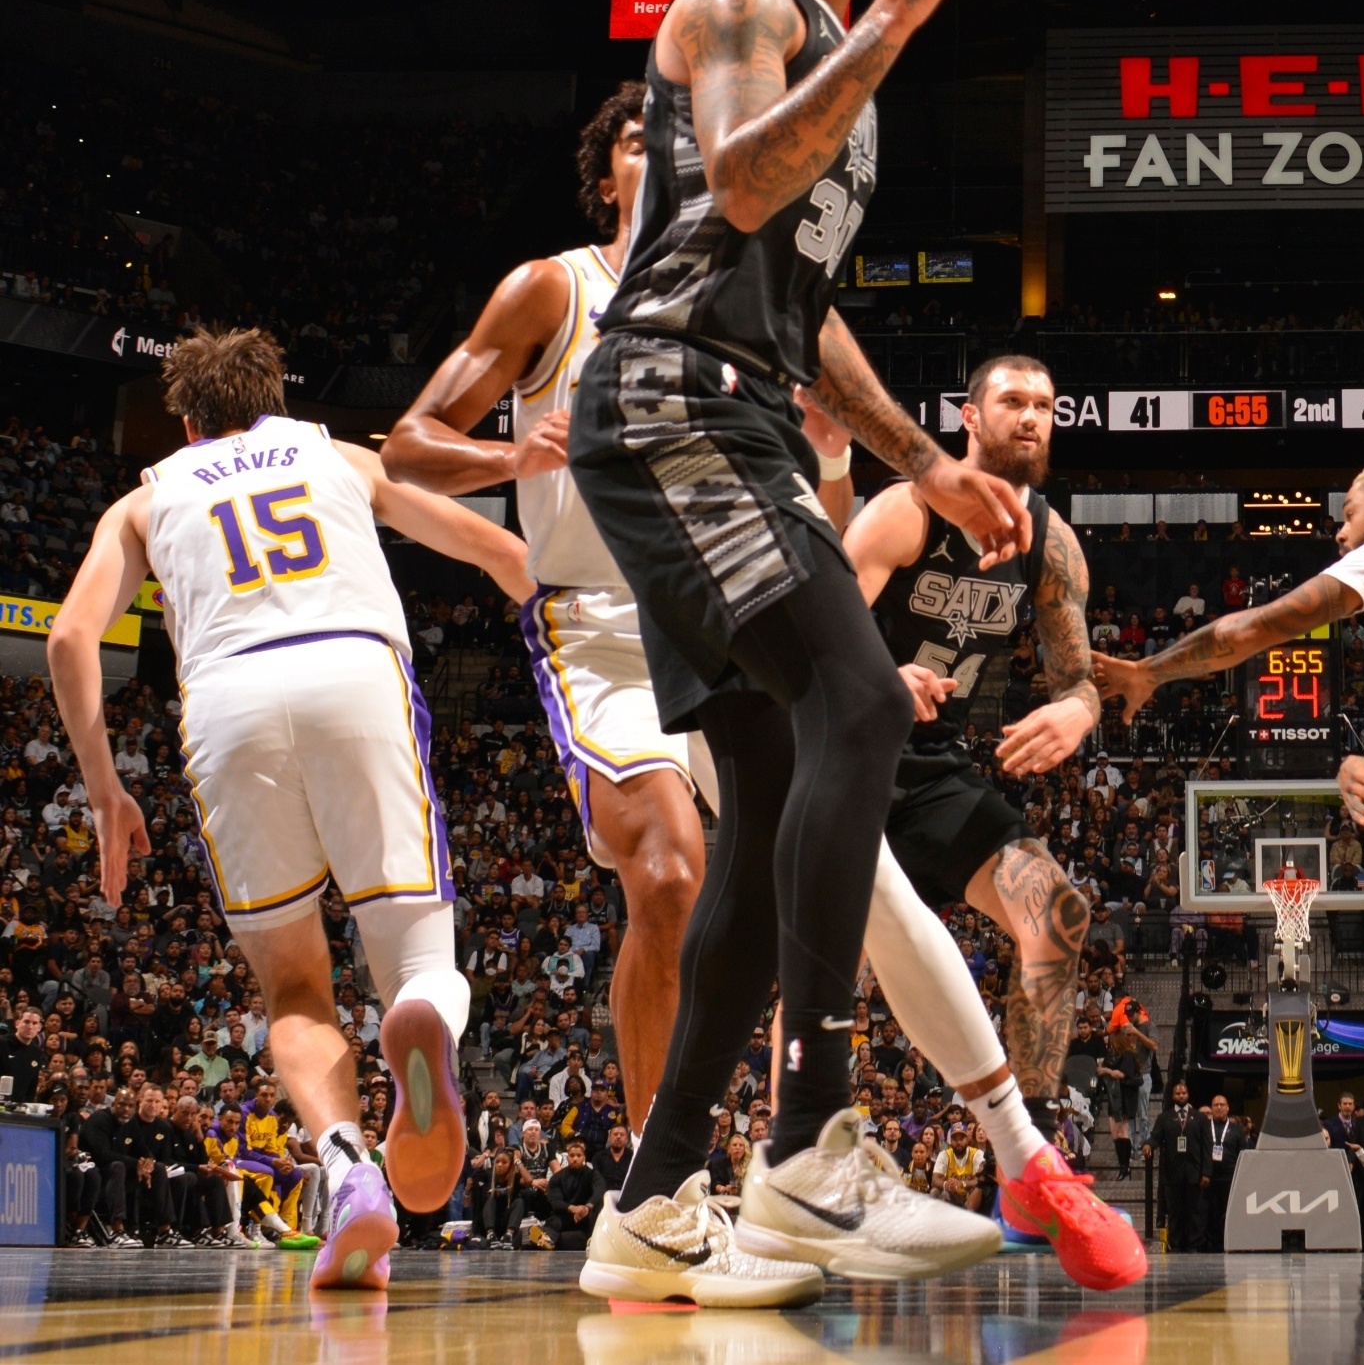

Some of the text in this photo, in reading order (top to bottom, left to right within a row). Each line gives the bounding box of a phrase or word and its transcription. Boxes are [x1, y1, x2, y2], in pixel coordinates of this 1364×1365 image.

[1083, 132, 1233, 187] FAN
[498, 415, 509, 434] 11
[1054, 395, 1102, 427] SA
[1130, 395, 1160, 428] 41
[1208, 395, 1268, 426] 6:55
[1293, 398, 1335, 422] 2nd
[193, 446, 298, 485] REAVES
[209, 481, 330, 594] 15
[909, 570, 1028, 635] SATX
[1269, 650, 1323, 674] 6:55
[1259, 676, 1318, 719] 24
[1271, 728, 1330, 740] TISSOT
